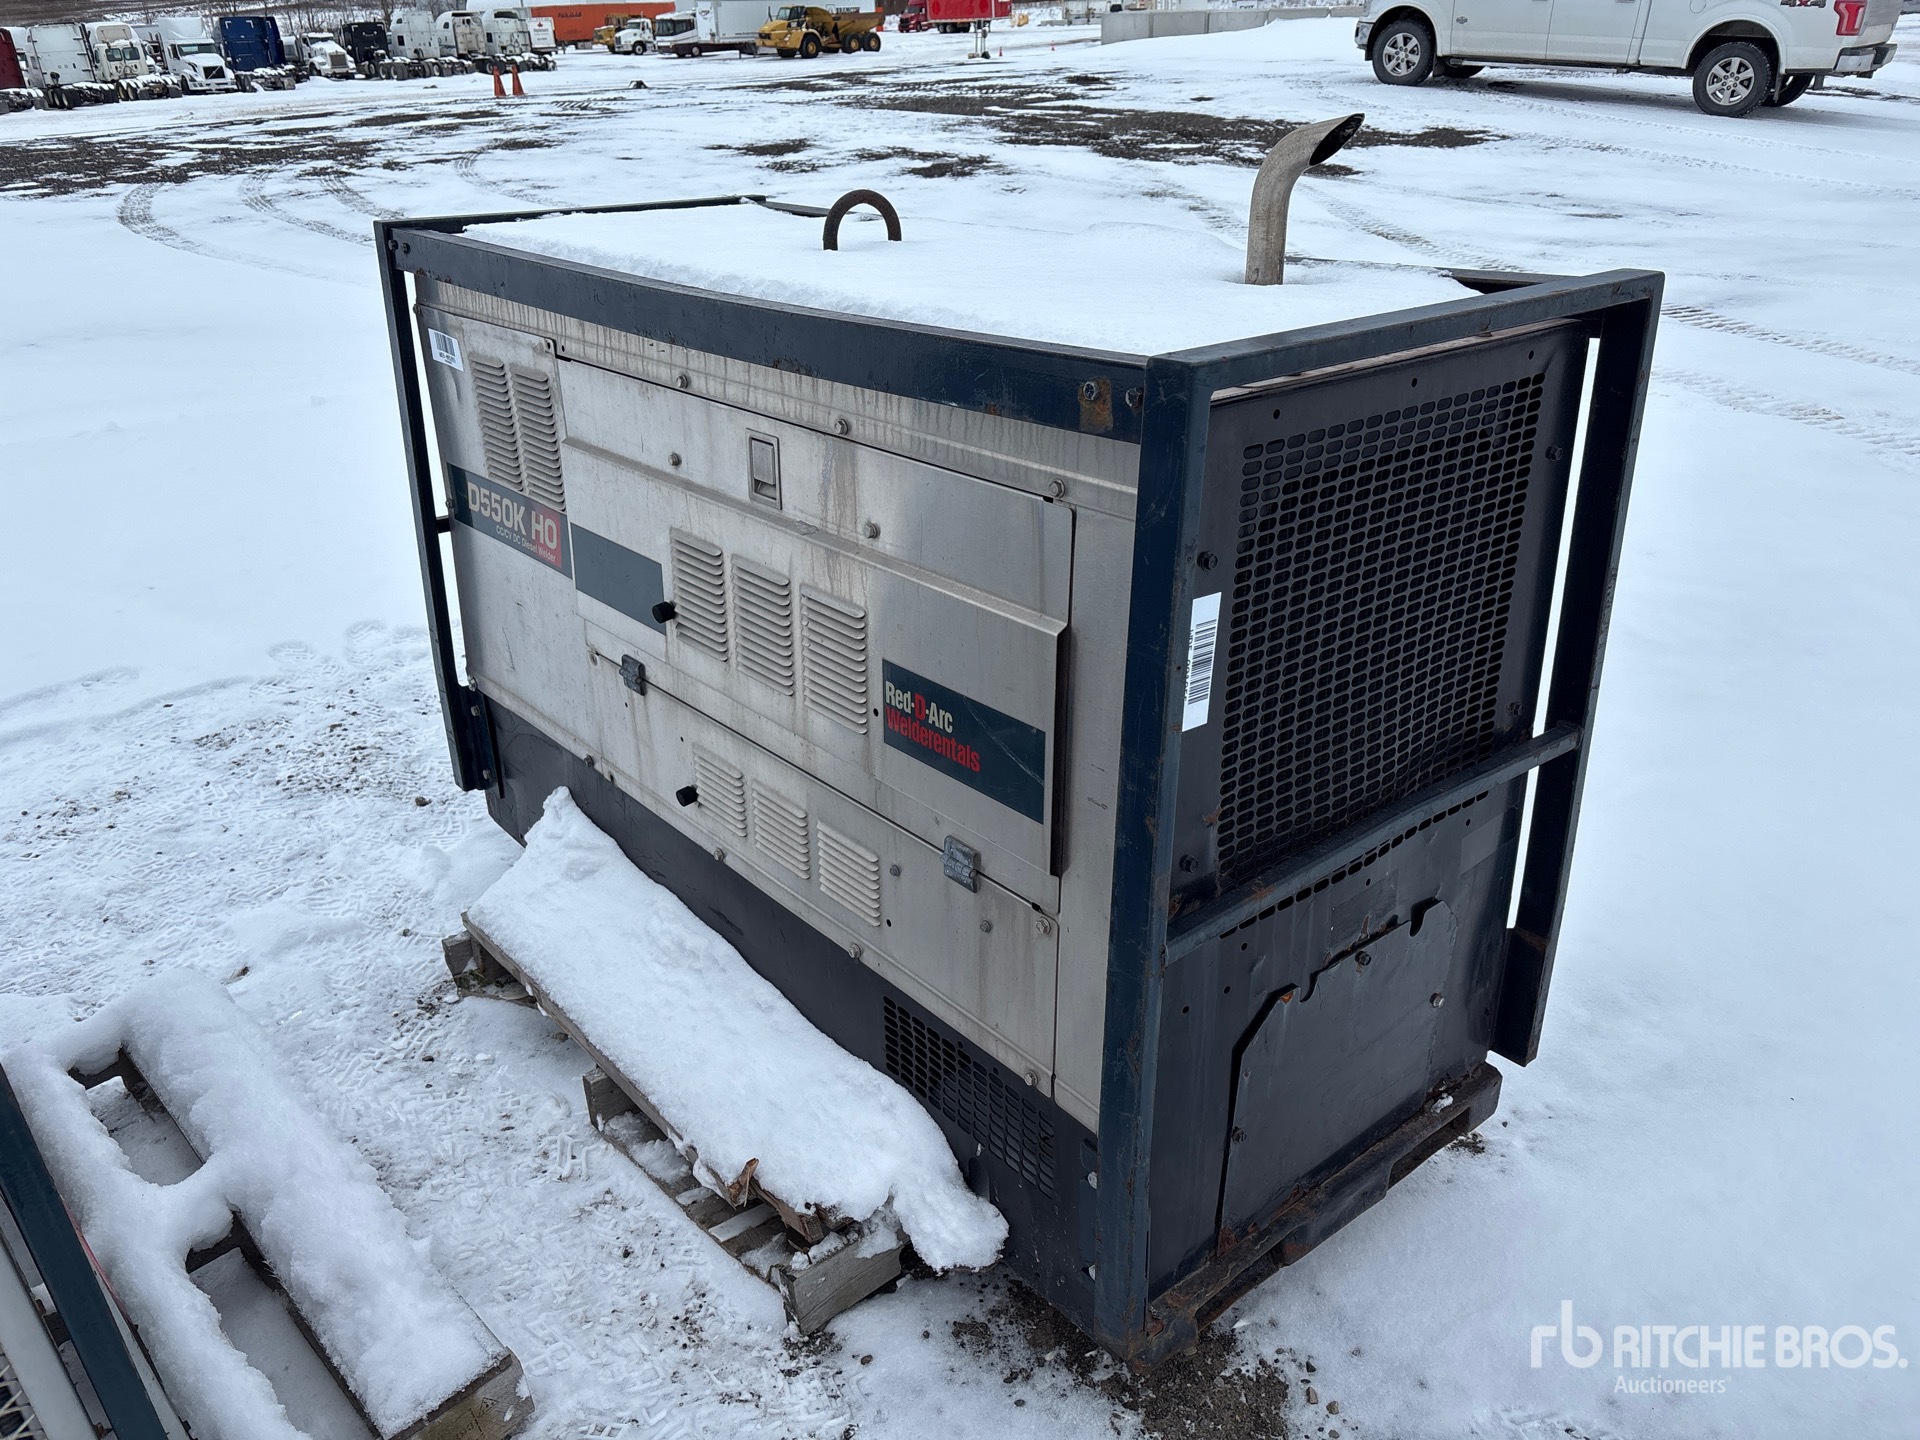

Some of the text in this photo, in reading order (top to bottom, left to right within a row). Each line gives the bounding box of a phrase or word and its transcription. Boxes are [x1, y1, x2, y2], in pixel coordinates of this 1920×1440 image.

[468, 481, 558, 550] D550K HO
[513, 533, 521, 545] DC
[521, 537, 538, 553] Diesel
[538, 545, 556, 562] Welder
[885, 680, 953, 734] Red-D-Arc
[886, 707, 981, 773] Welderentals
